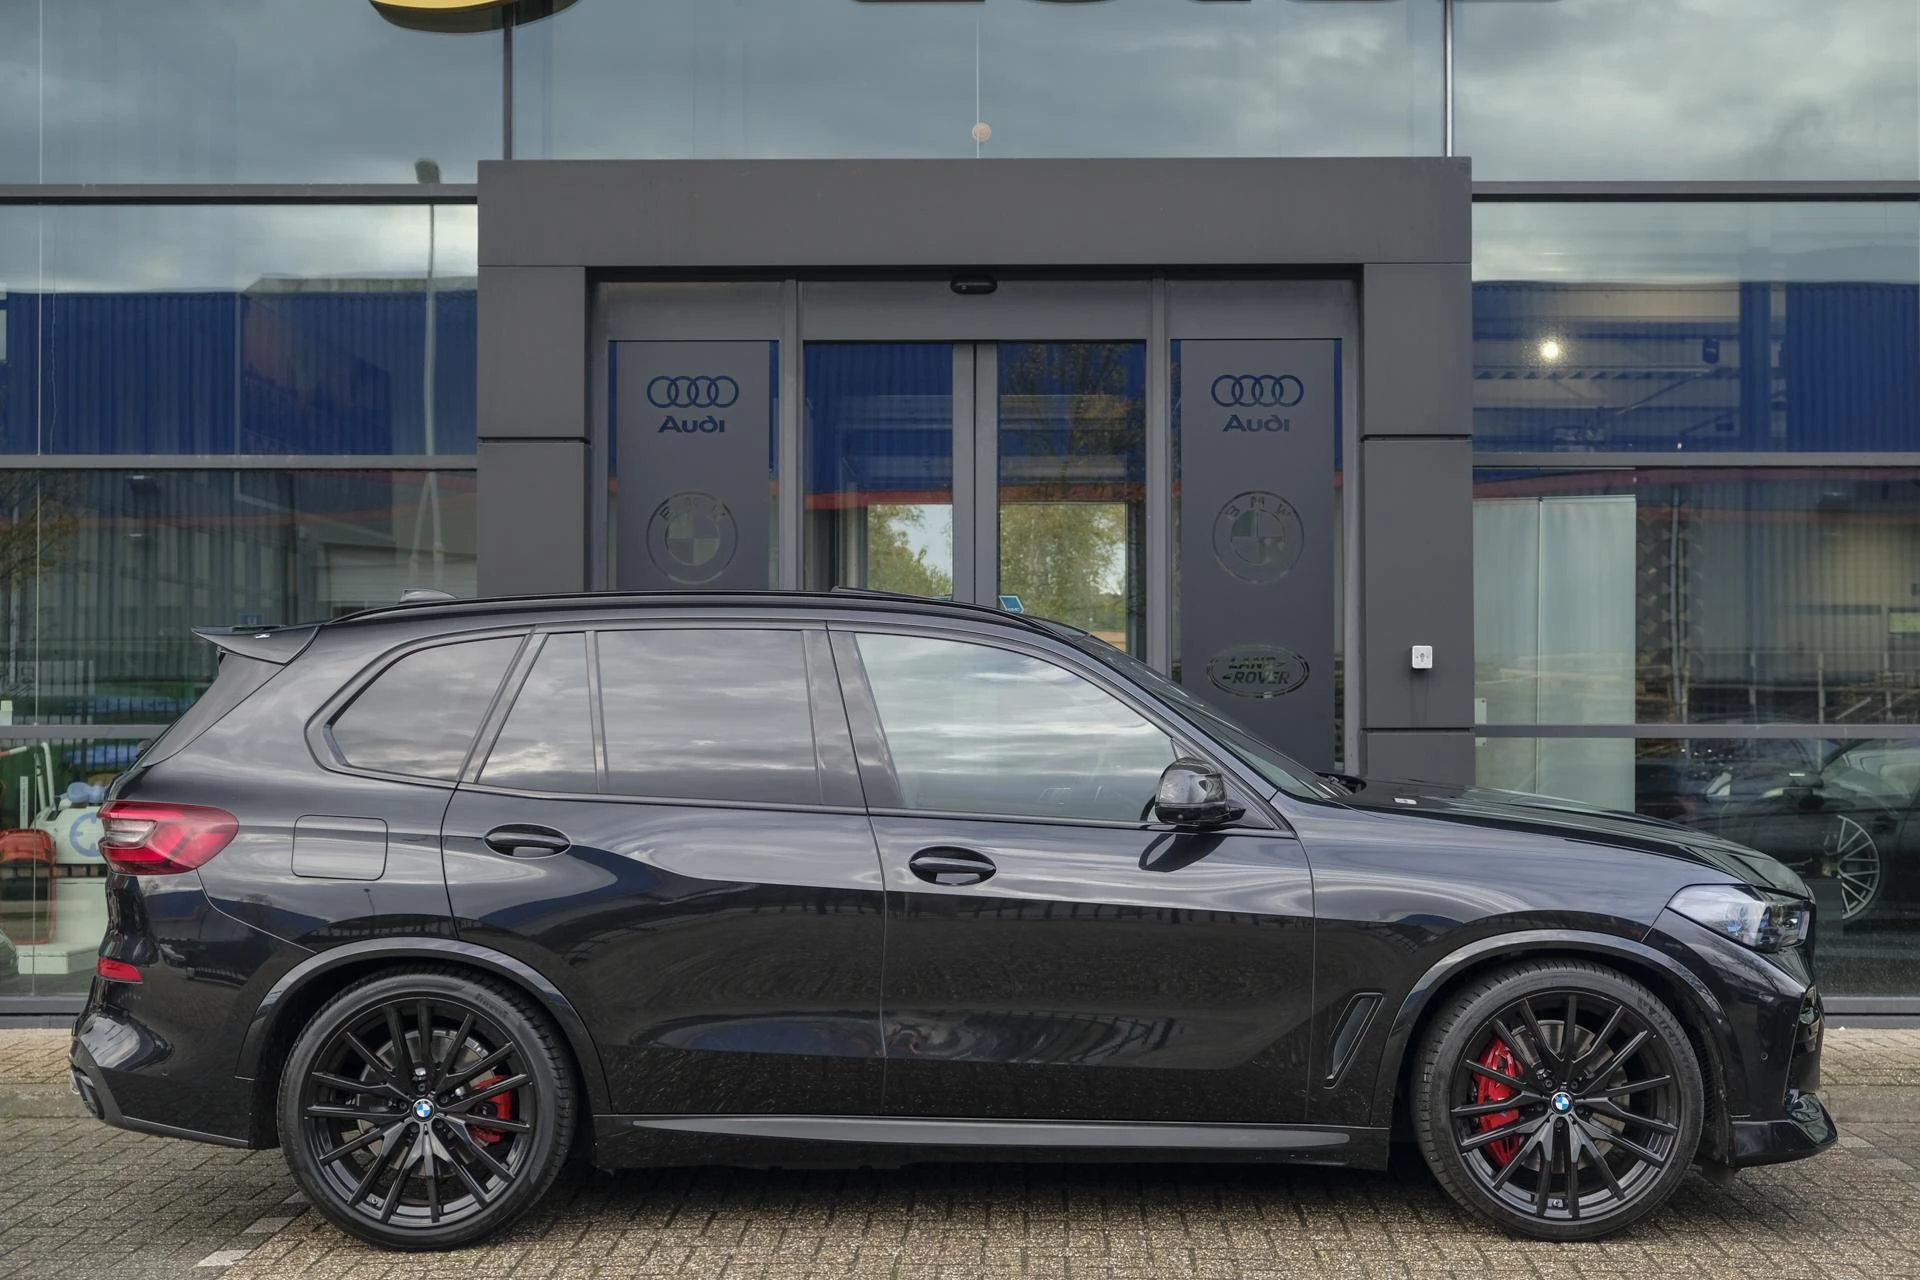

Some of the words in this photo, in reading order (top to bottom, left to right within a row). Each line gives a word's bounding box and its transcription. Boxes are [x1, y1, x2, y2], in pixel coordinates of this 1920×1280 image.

[658, 416, 725, 433] Audi
[1223, 415, 1290, 432] Audi
[1231, 671, 1290, 684] ROVER
